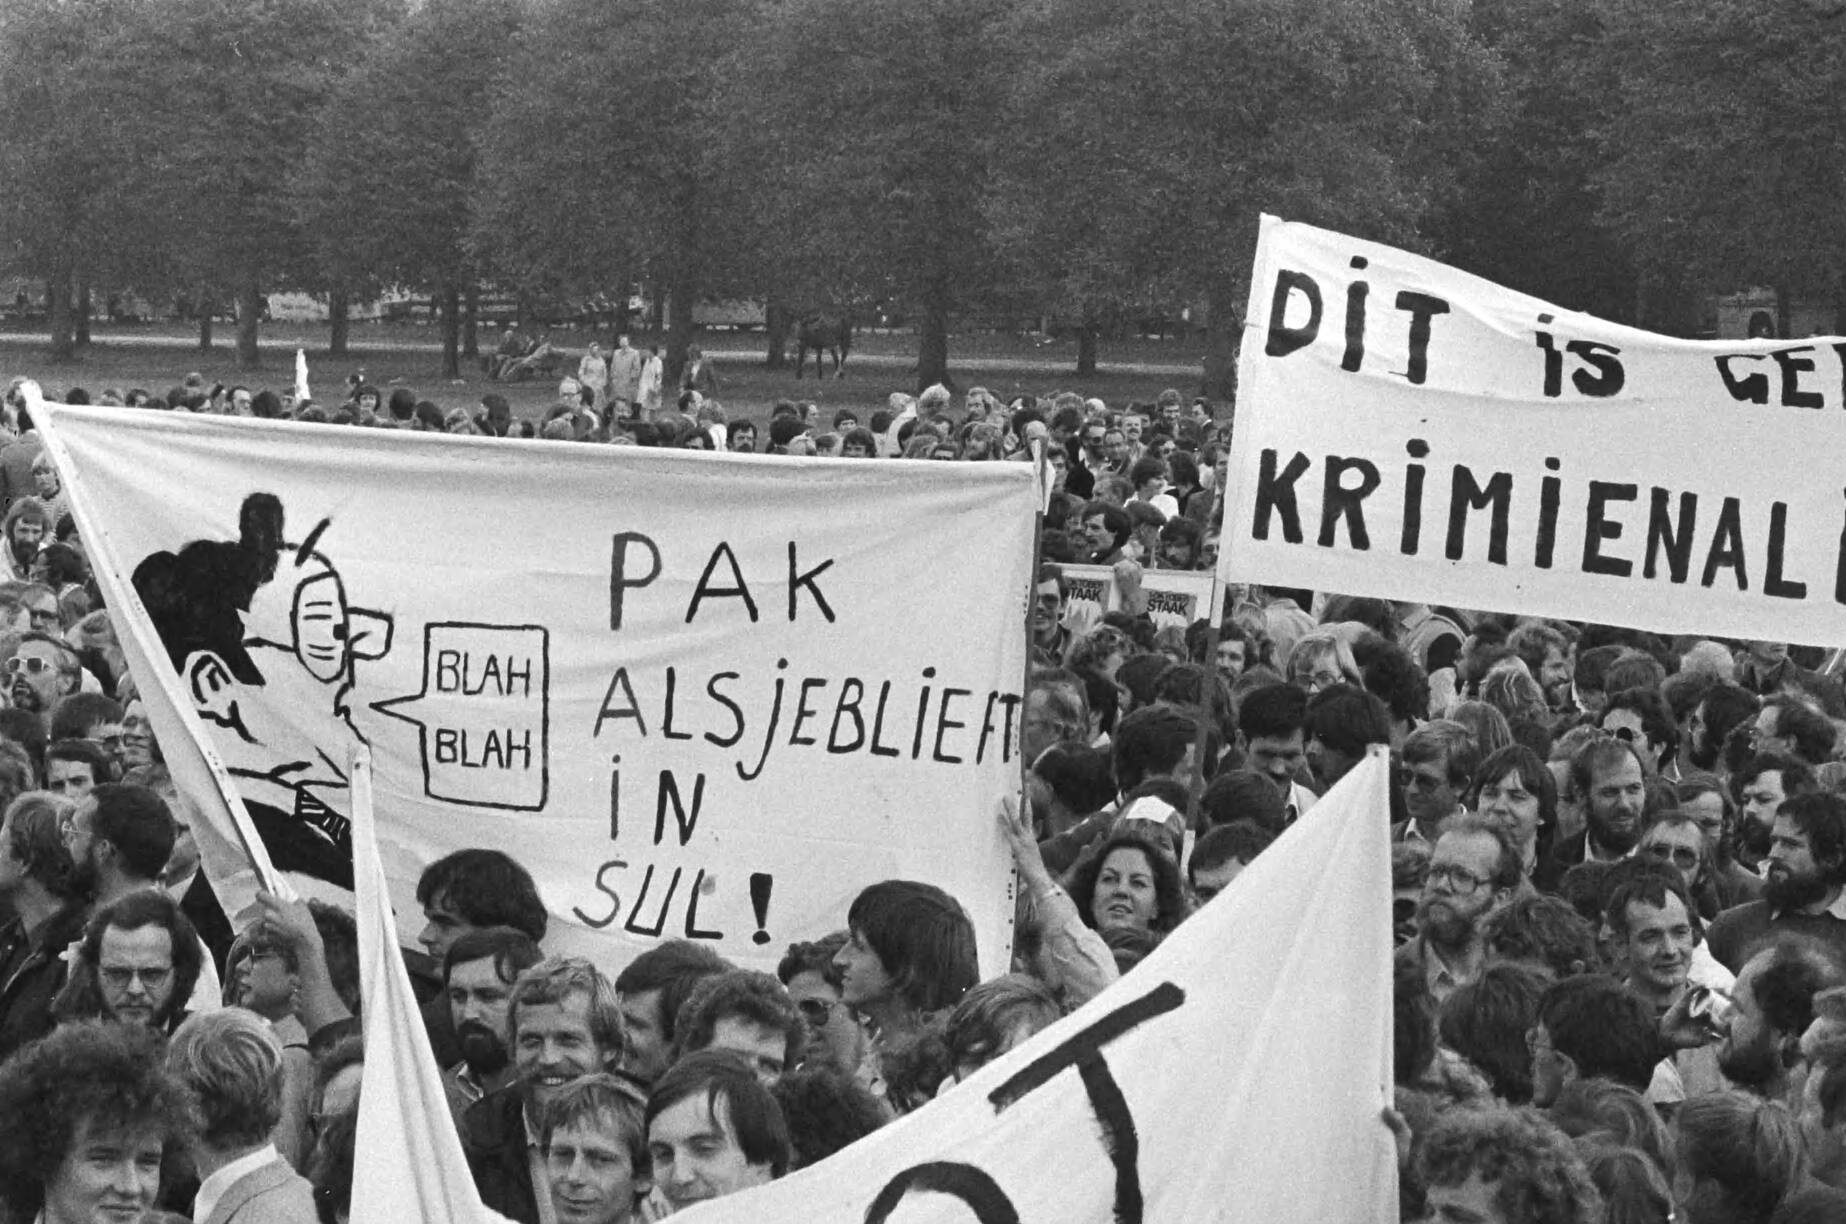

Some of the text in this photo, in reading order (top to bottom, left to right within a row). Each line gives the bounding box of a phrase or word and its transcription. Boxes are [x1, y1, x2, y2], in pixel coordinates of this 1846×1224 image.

[609, 531, 836, 632] PAK
[1146, 598, 1188, 616] STAAK
[435, 648, 532, 698] BLAH
[434, 726, 532, 771] BLAH
